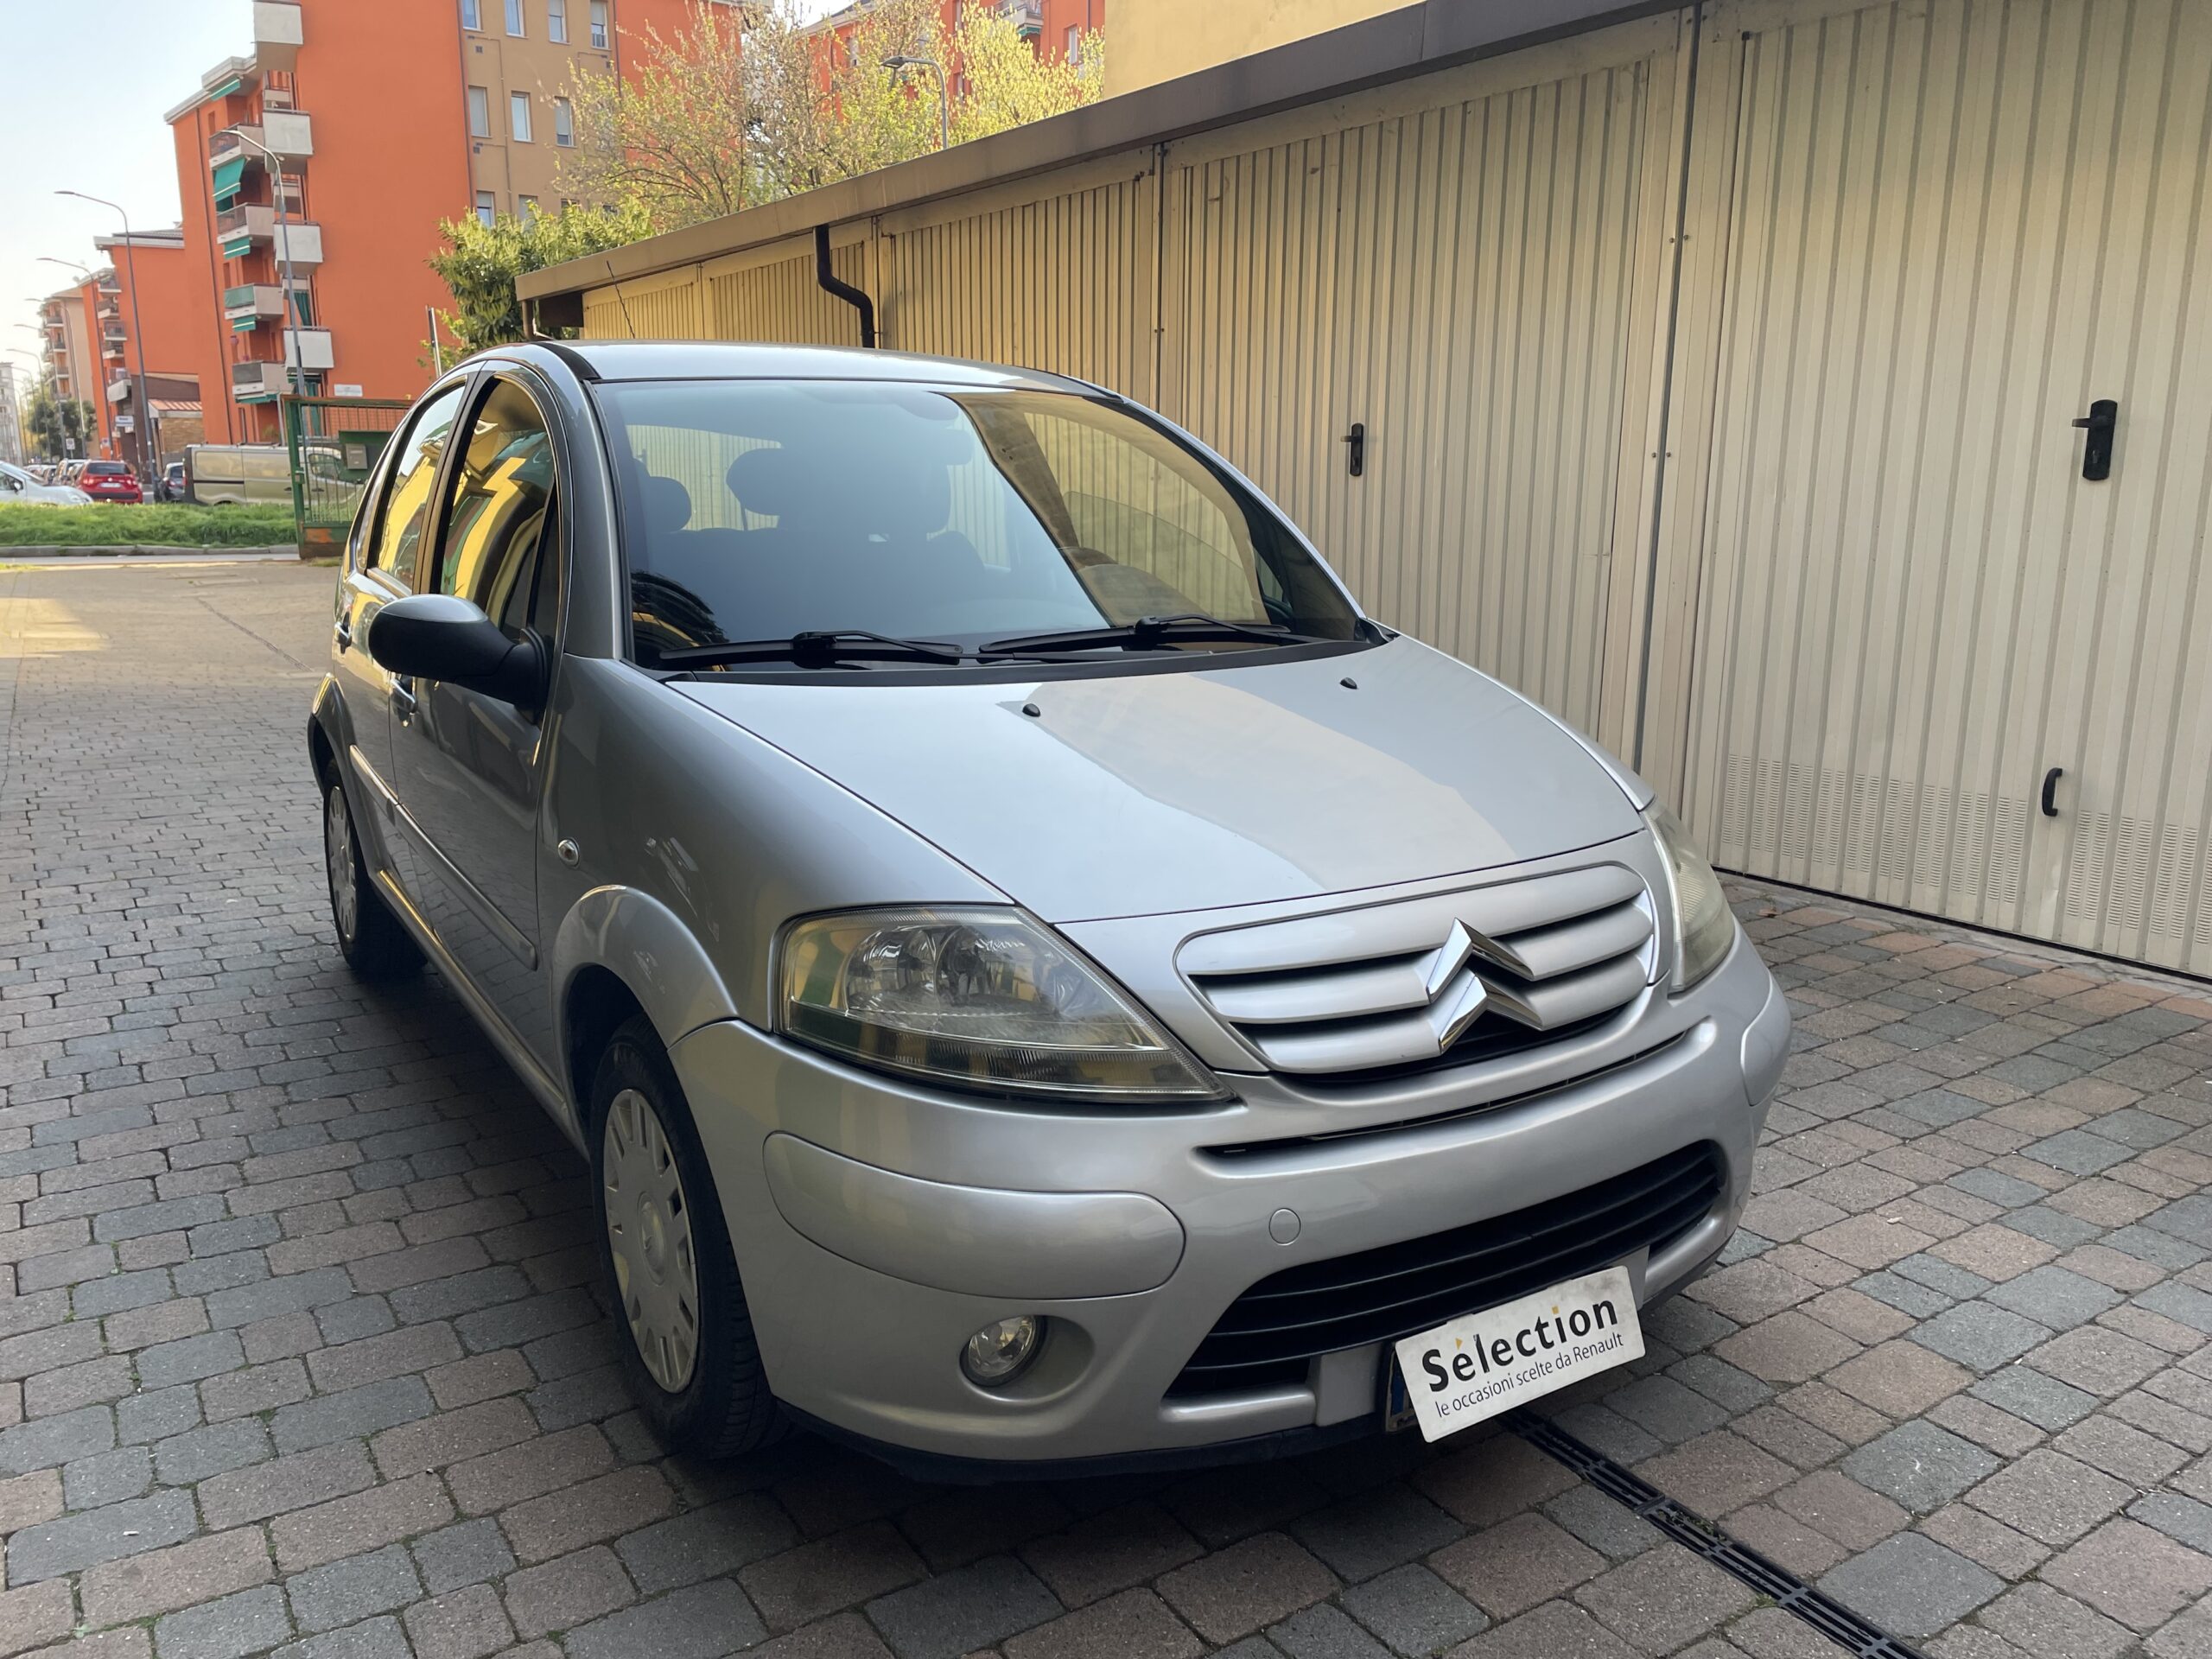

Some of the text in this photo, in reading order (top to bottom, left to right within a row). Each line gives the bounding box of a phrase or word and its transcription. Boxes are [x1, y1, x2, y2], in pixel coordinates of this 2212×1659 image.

[1435, 1332, 1624, 1417] le occasioni scelte da Renault
